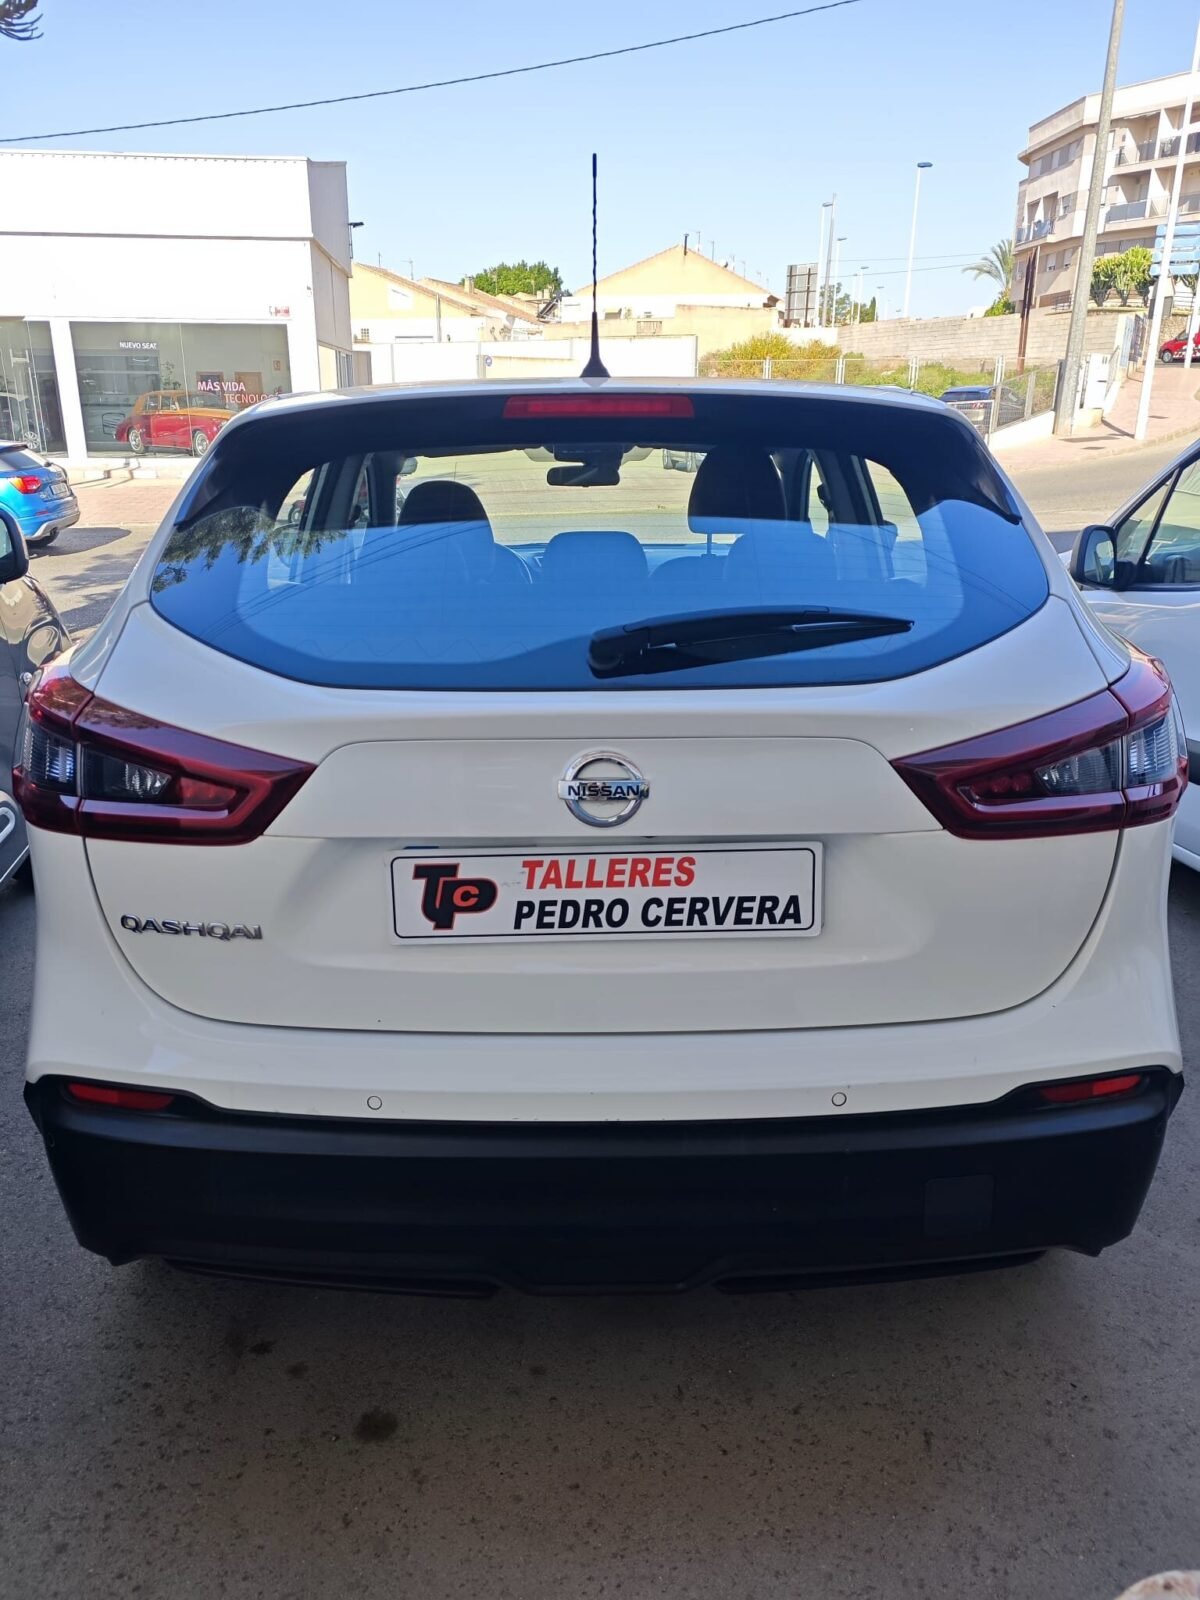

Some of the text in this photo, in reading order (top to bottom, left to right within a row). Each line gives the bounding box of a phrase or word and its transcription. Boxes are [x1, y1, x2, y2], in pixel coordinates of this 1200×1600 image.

[120, 341, 141, 349] NUEVO
[197, 379, 246, 392] MÁS VIDA
[224, 392, 278, 404] TECNOLO
[568, 785, 640, 797] NISSAN
[521, 856, 697, 890] TALLERES
[513, 895, 802, 930] PEDRO CERVERA
[120, 914, 263, 940] QASHQAI
